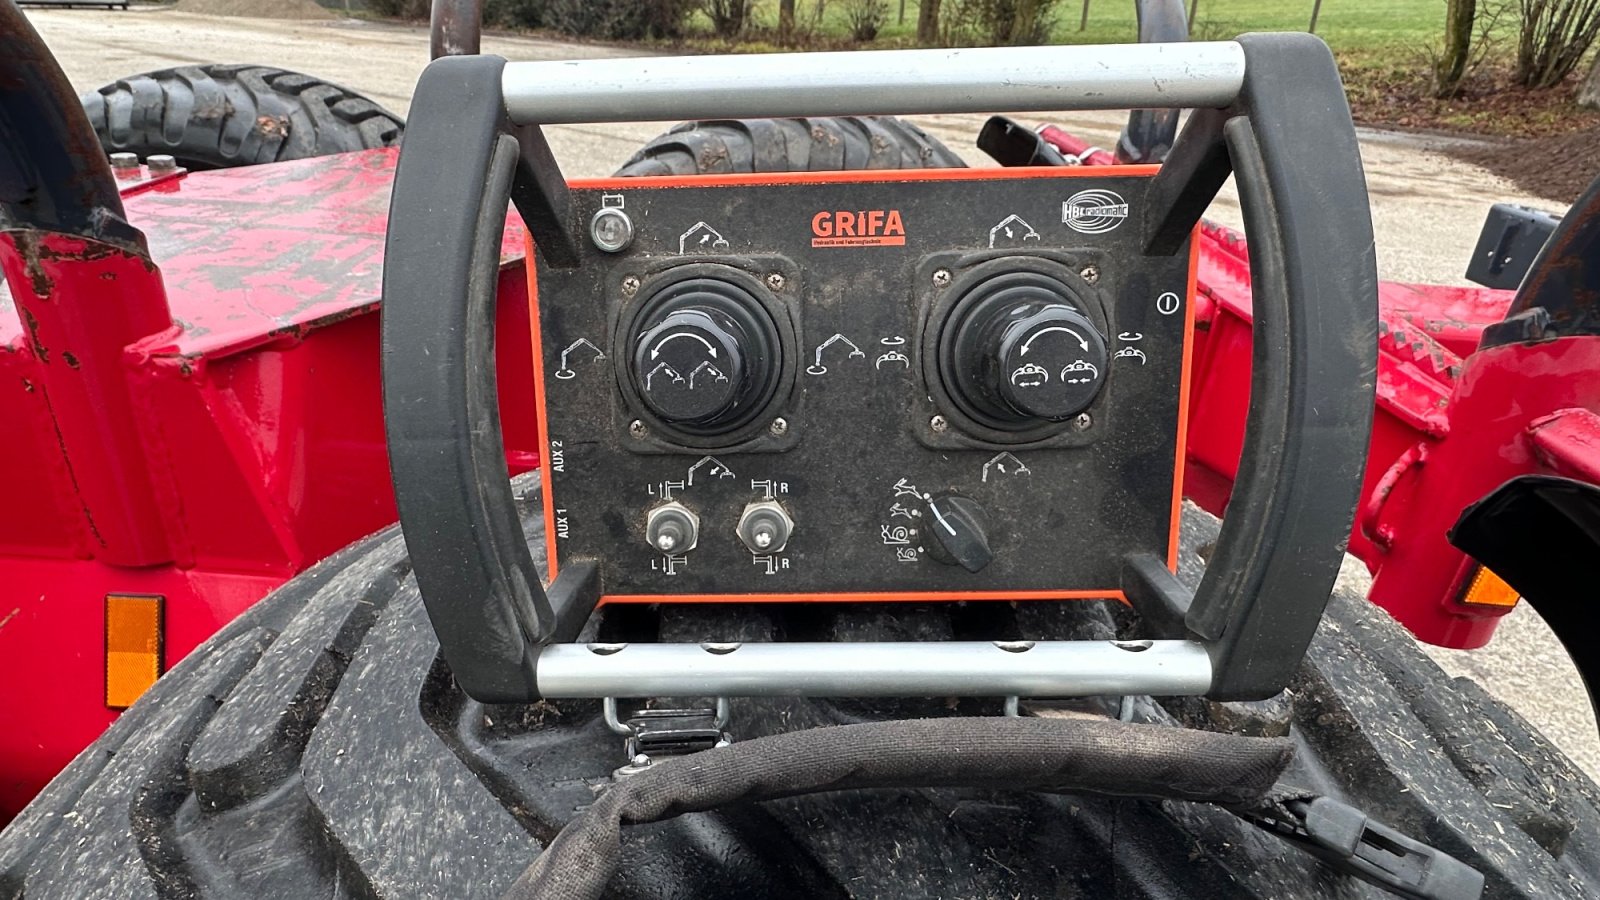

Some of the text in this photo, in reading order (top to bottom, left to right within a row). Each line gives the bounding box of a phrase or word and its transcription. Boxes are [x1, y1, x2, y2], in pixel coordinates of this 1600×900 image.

[552, 450, 564, 472] AUX
[648, 484, 654, 494] L
[781, 483, 789, 493] R
[557, 517, 569, 538] AUX
[651, 560, 657, 569] L
[782, 559, 790, 568] R
